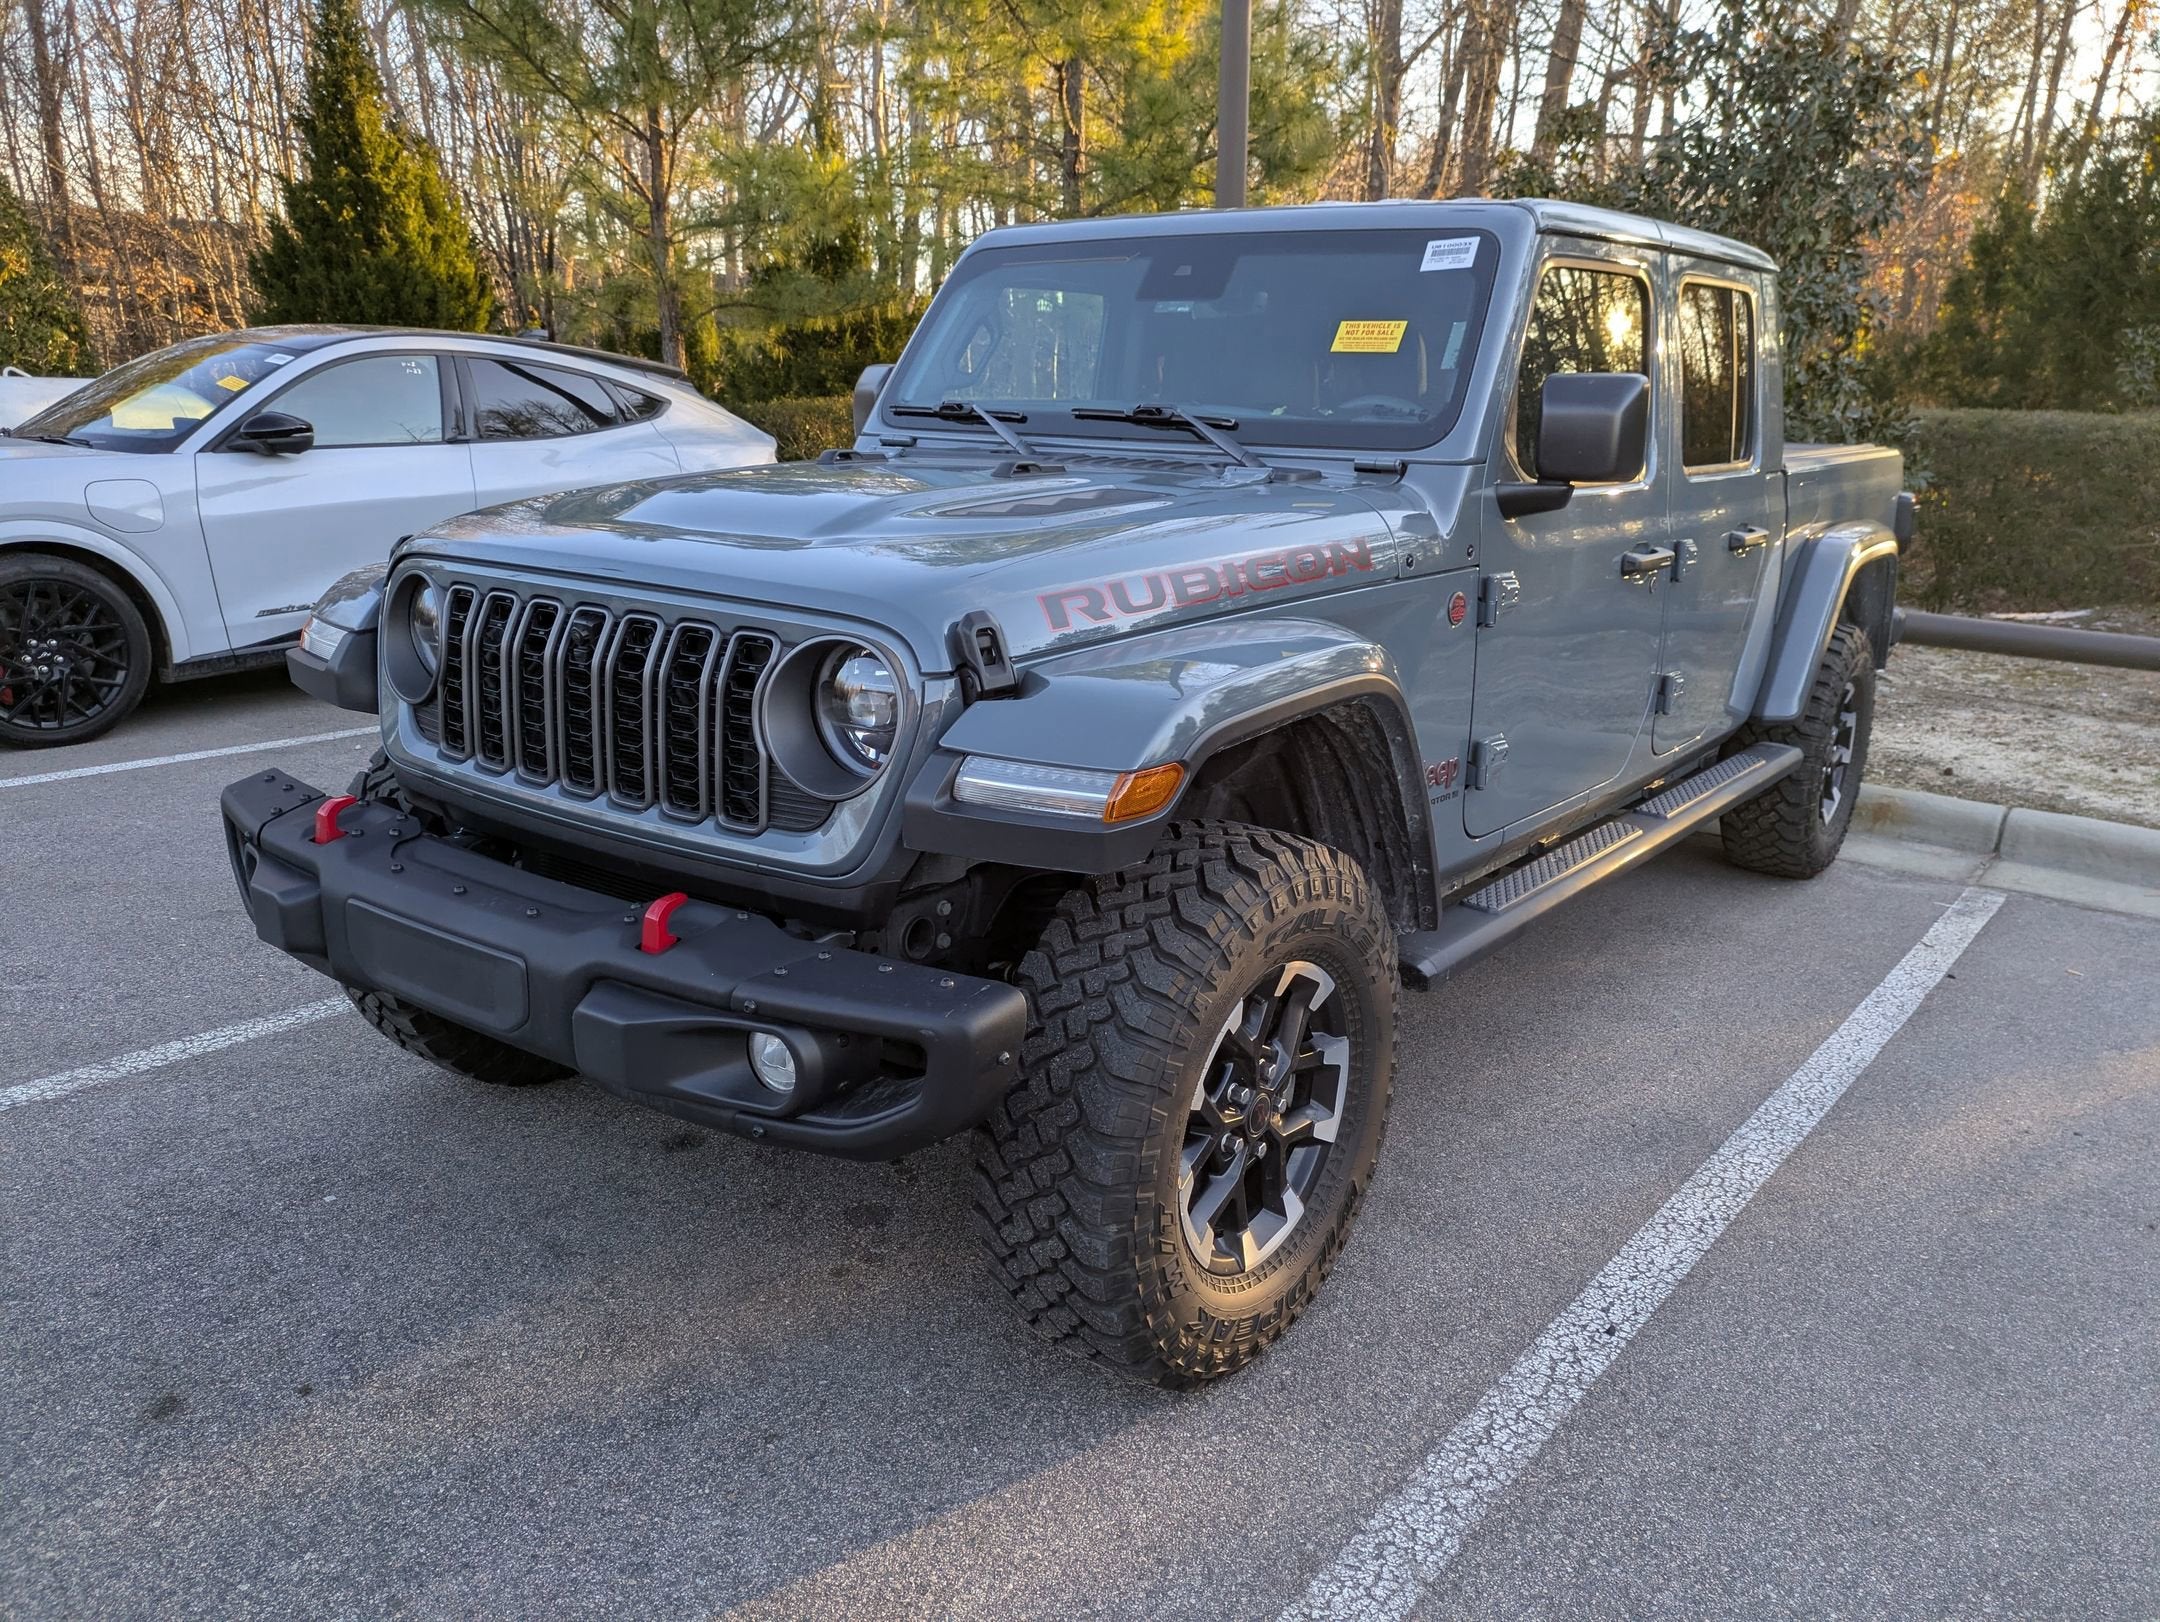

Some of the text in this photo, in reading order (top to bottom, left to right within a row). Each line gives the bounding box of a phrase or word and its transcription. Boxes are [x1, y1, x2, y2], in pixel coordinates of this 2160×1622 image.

[1037, 536, 1373, 632] RUBICON
[1423, 757, 1458, 789] eep
[1189, 1179, 1357, 1342] WILDPEAK
